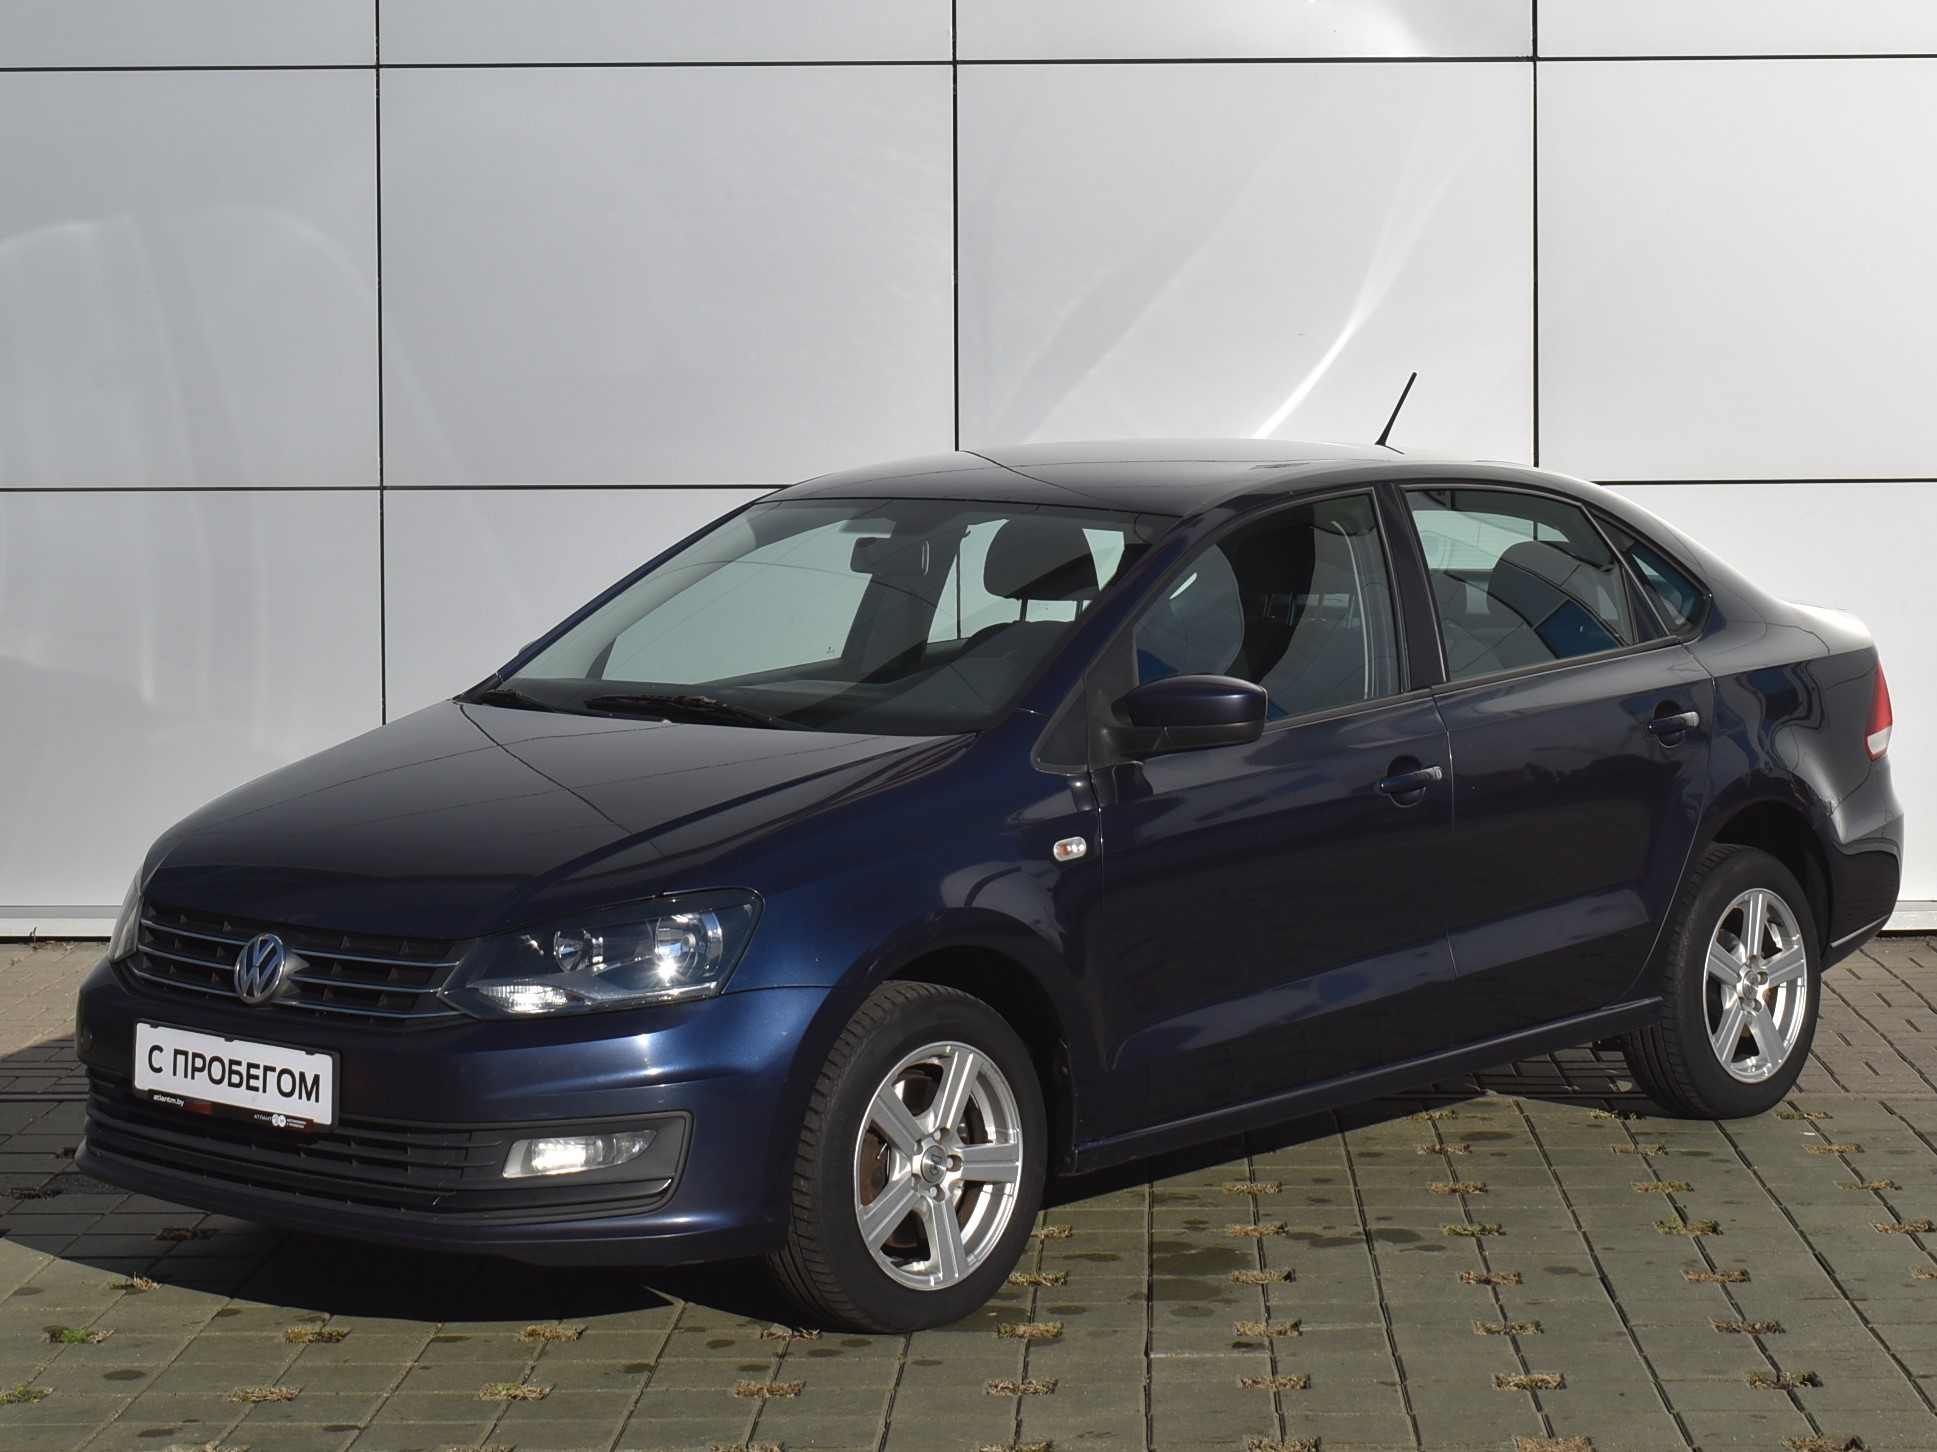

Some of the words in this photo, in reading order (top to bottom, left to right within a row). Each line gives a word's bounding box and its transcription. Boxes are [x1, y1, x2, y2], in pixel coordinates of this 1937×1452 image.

[148, 1044, 164, 1074] С
[172, 1048, 320, 1103] ПРОБЕГОМ
[153, 1094, 185, 1107] atlantm.by
